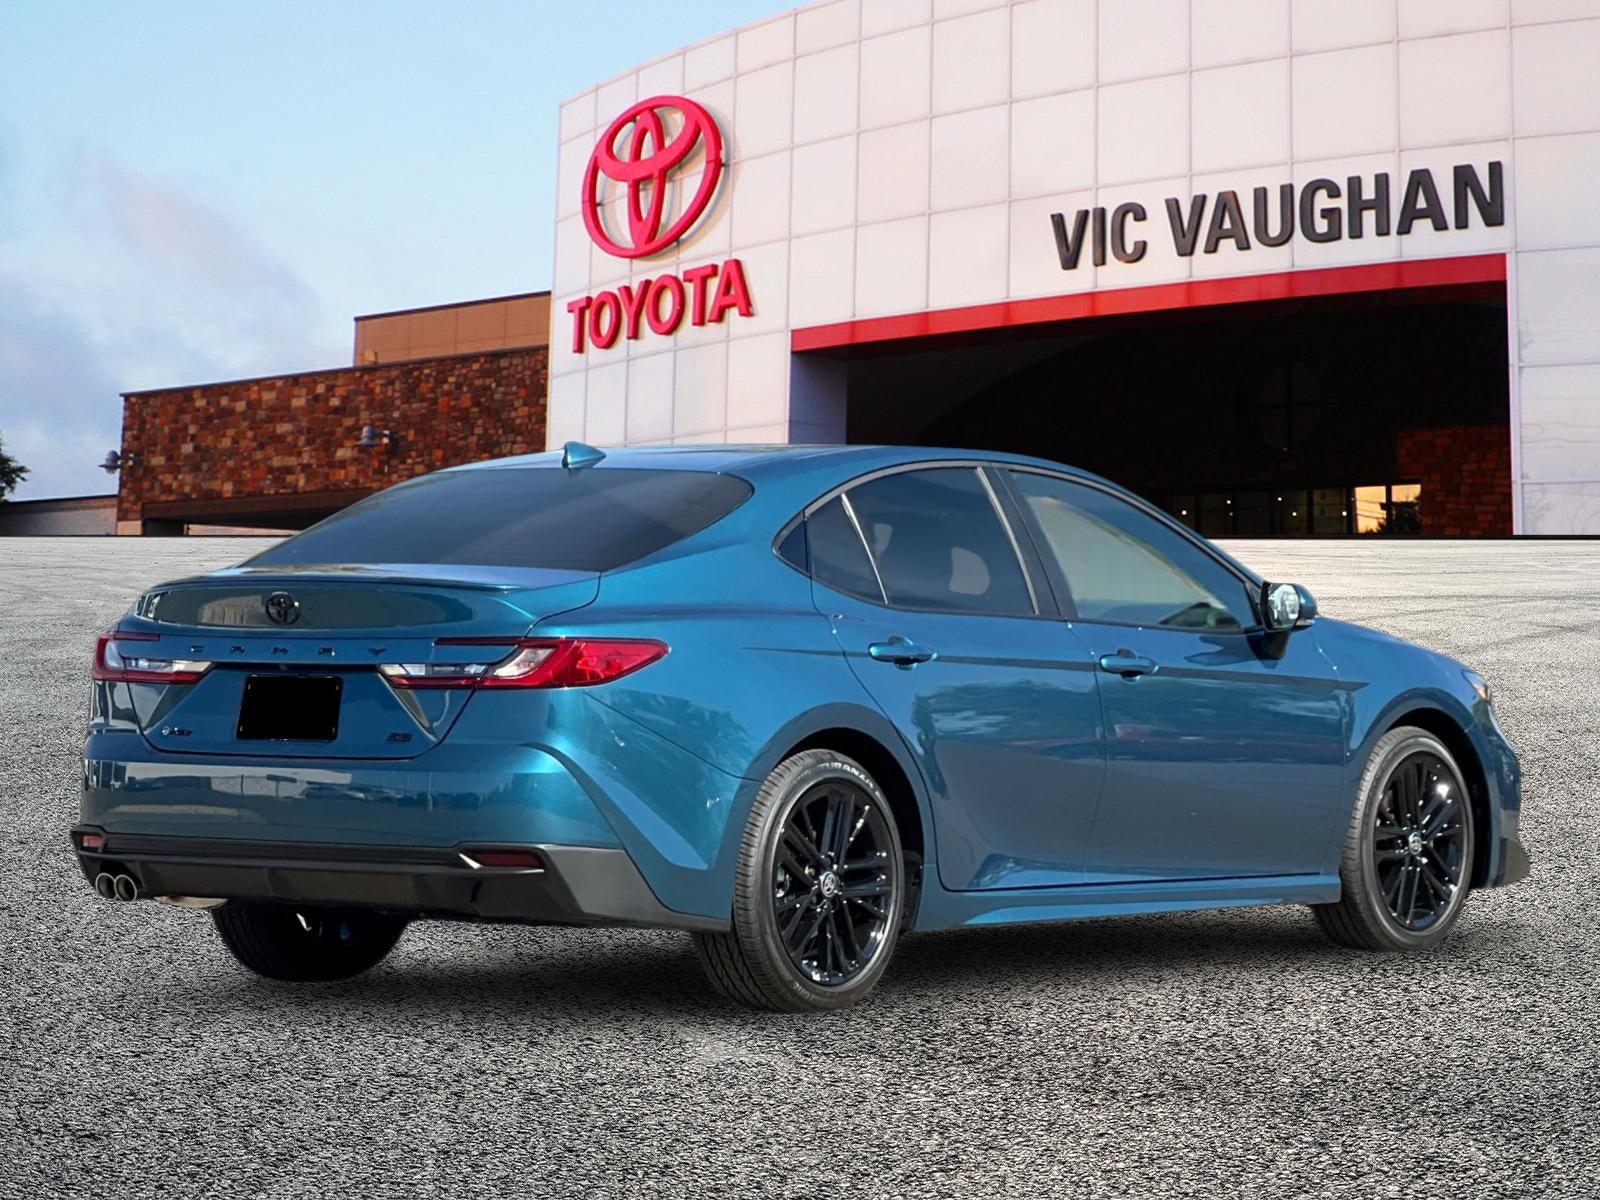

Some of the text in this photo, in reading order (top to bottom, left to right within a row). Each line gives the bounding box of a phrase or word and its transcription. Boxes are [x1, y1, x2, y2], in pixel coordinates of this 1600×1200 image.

[1050, 160, 1505, 271] VIC VAUGHAN
[567, 258, 754, 353] TOYOTA
